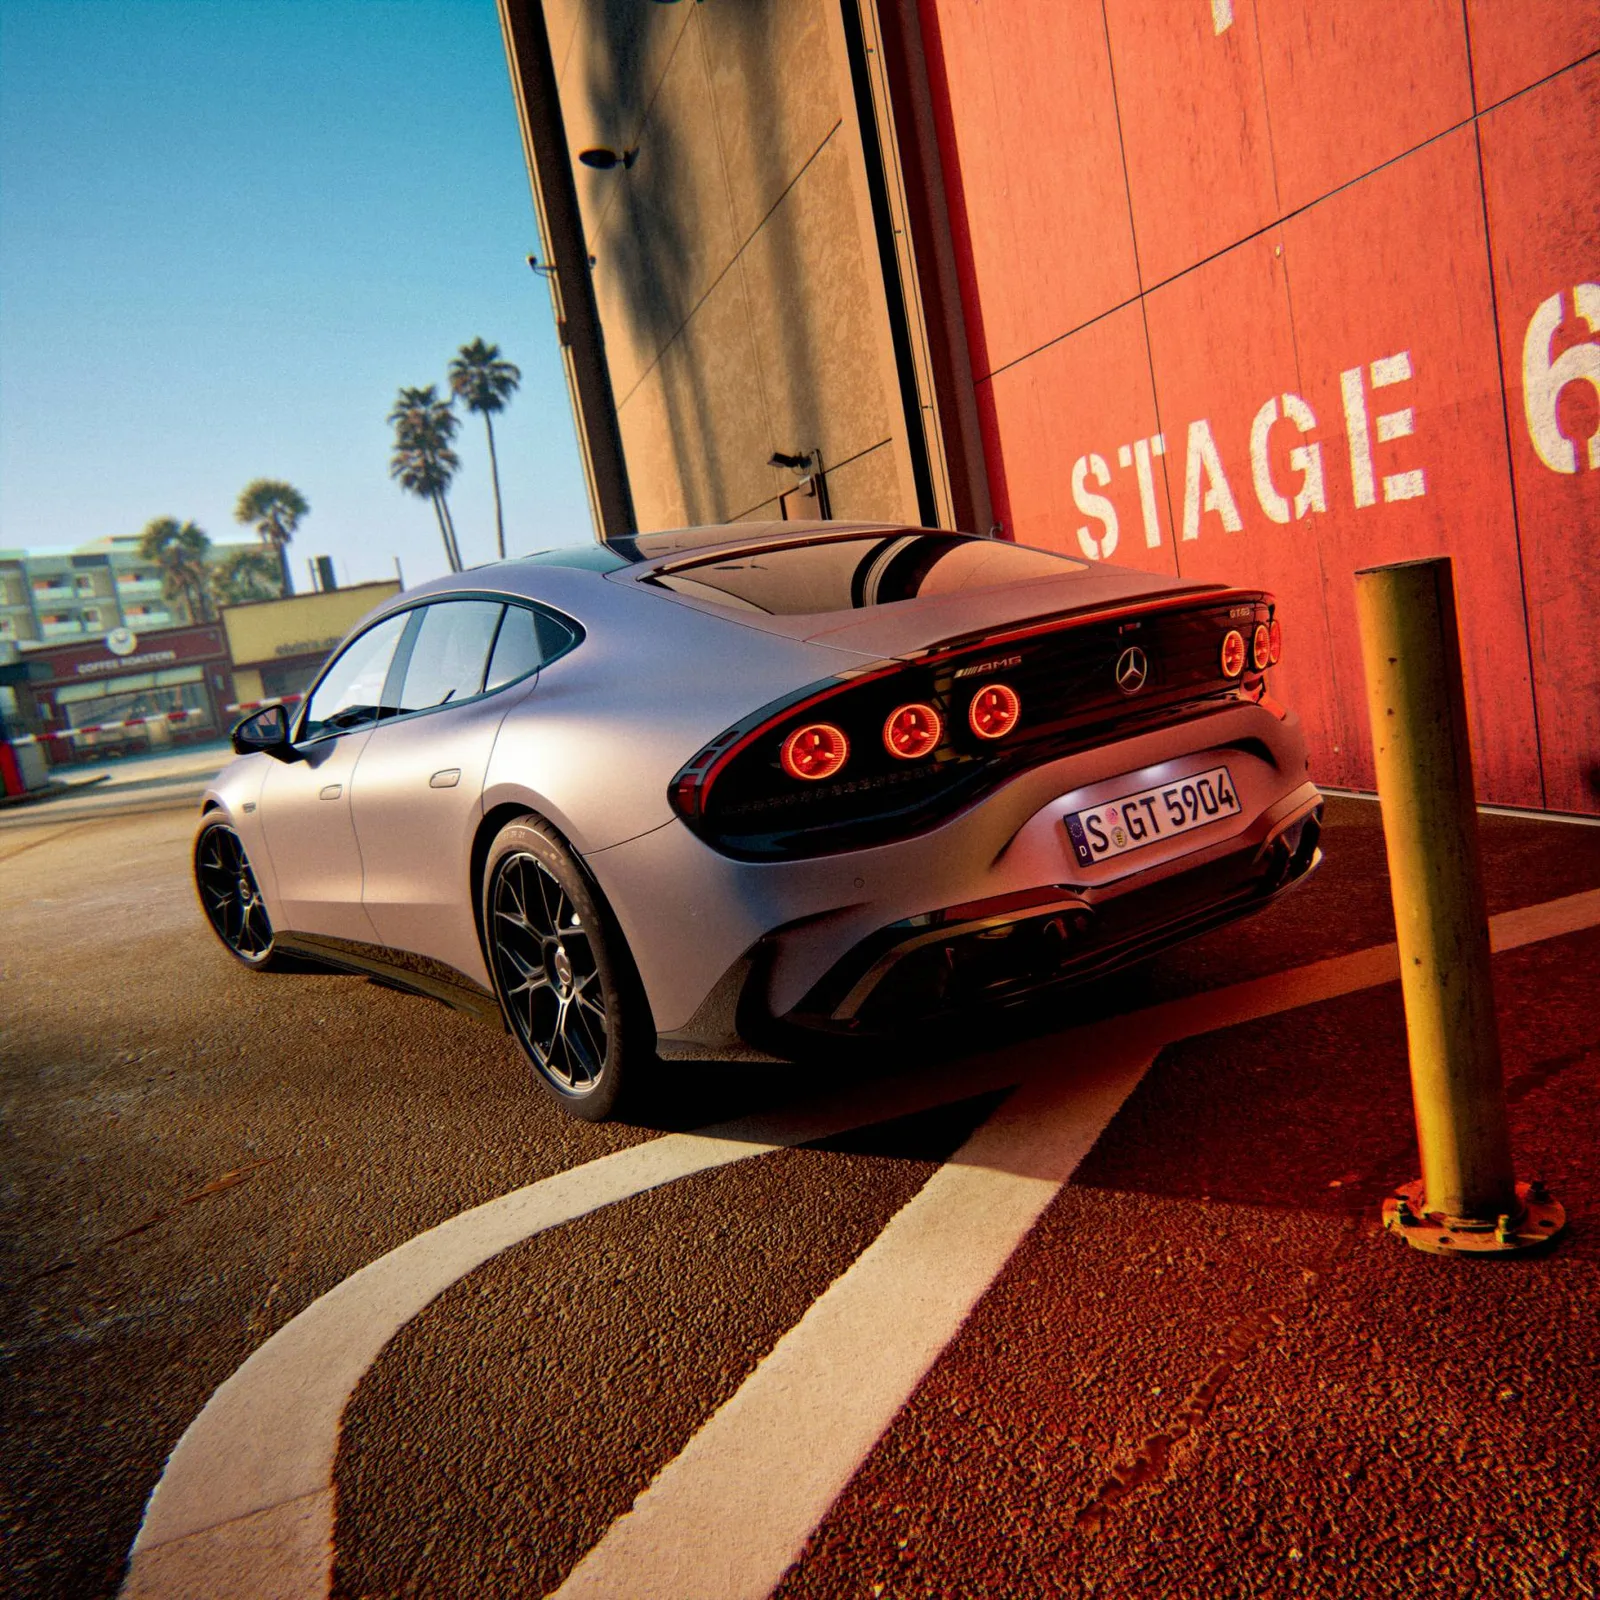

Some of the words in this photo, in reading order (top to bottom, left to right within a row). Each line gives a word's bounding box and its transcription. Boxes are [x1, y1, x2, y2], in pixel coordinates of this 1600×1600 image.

[1071, 351, 1425, 560] STAGE
[1521, 282, 1600, 475] 6
[77, 659, 119, 674] COFFEE
[977, 655, 1022, 673] AMG
[1085, 814, 1109, 853] S
[1121, 796, 1160, 841] GT
[1162, 774, 1234, 826] 5904
[1079, 846, 1087, 857] D
